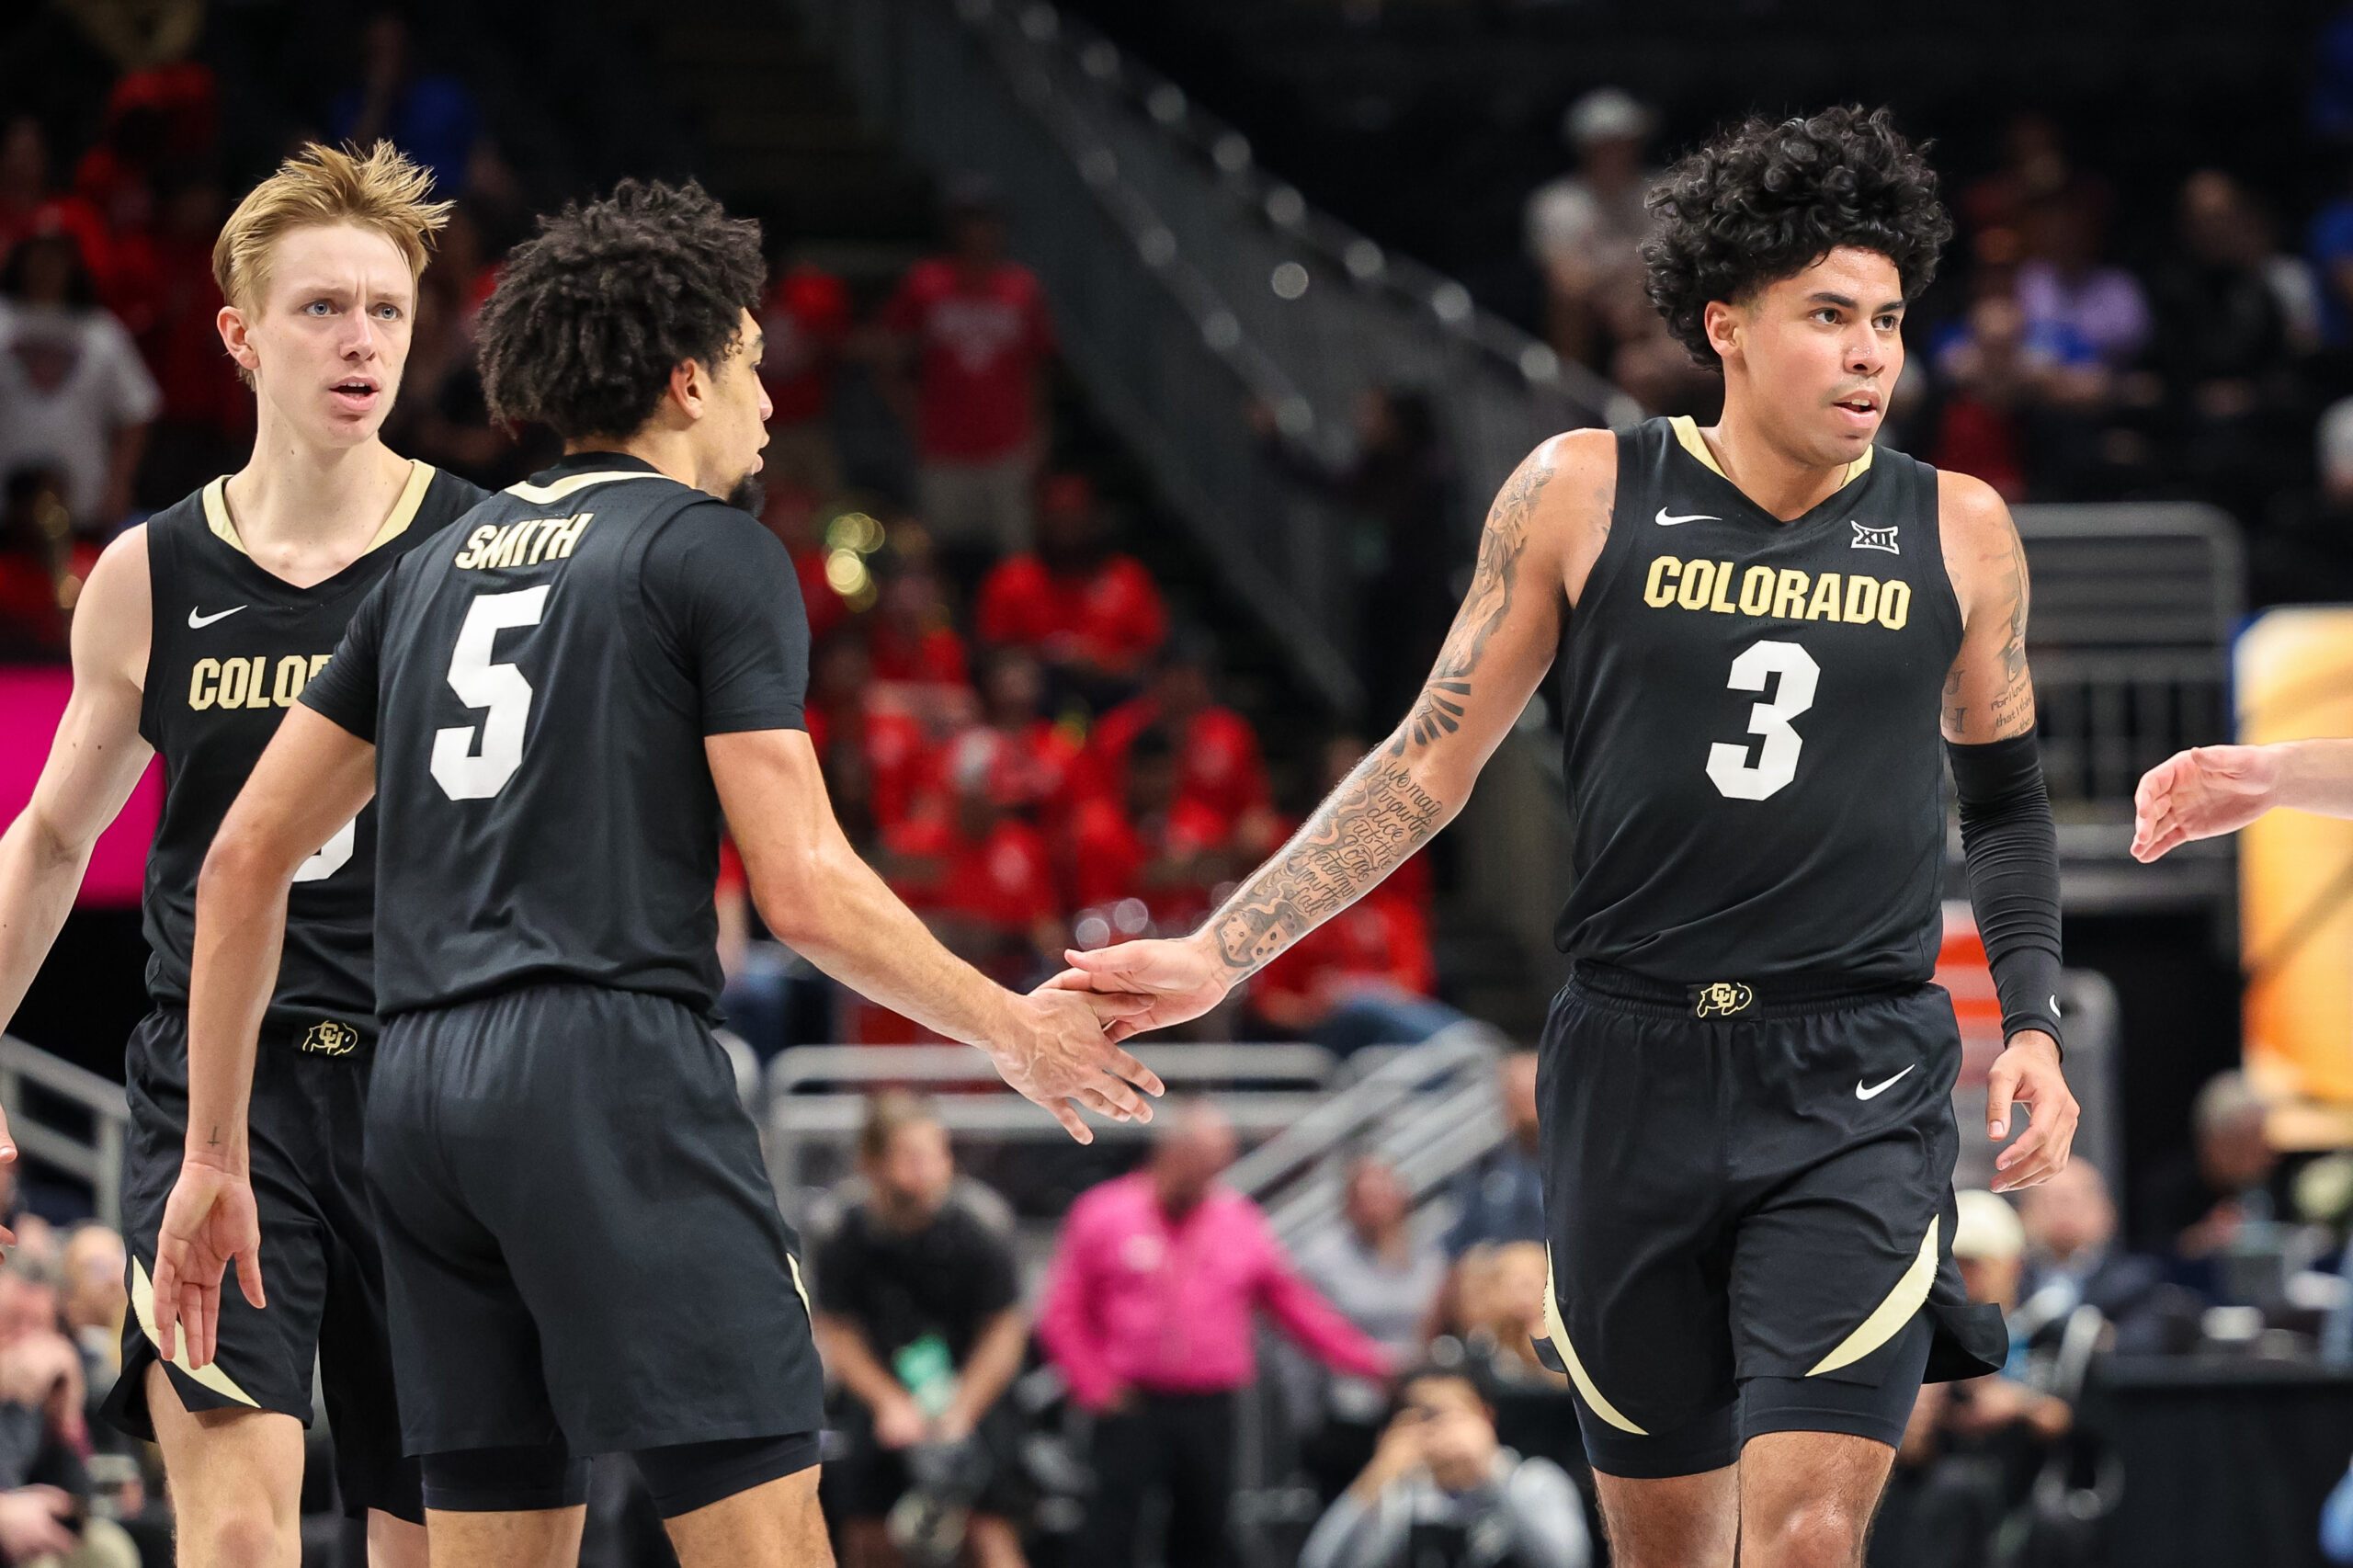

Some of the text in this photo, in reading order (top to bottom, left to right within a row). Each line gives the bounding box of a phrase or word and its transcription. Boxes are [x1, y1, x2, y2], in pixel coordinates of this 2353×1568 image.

[454, 512, 595, 570] SMITH
[1643, 555, 1911, 631] COLORADO
[430, 584, 551, 801] 5
[1705, 640, 1821, 801] 3
[1366, 807, 1405, 843] dice
[1407, 782, 1442, 817] may
[1288, 887, 1318, 916] fall
